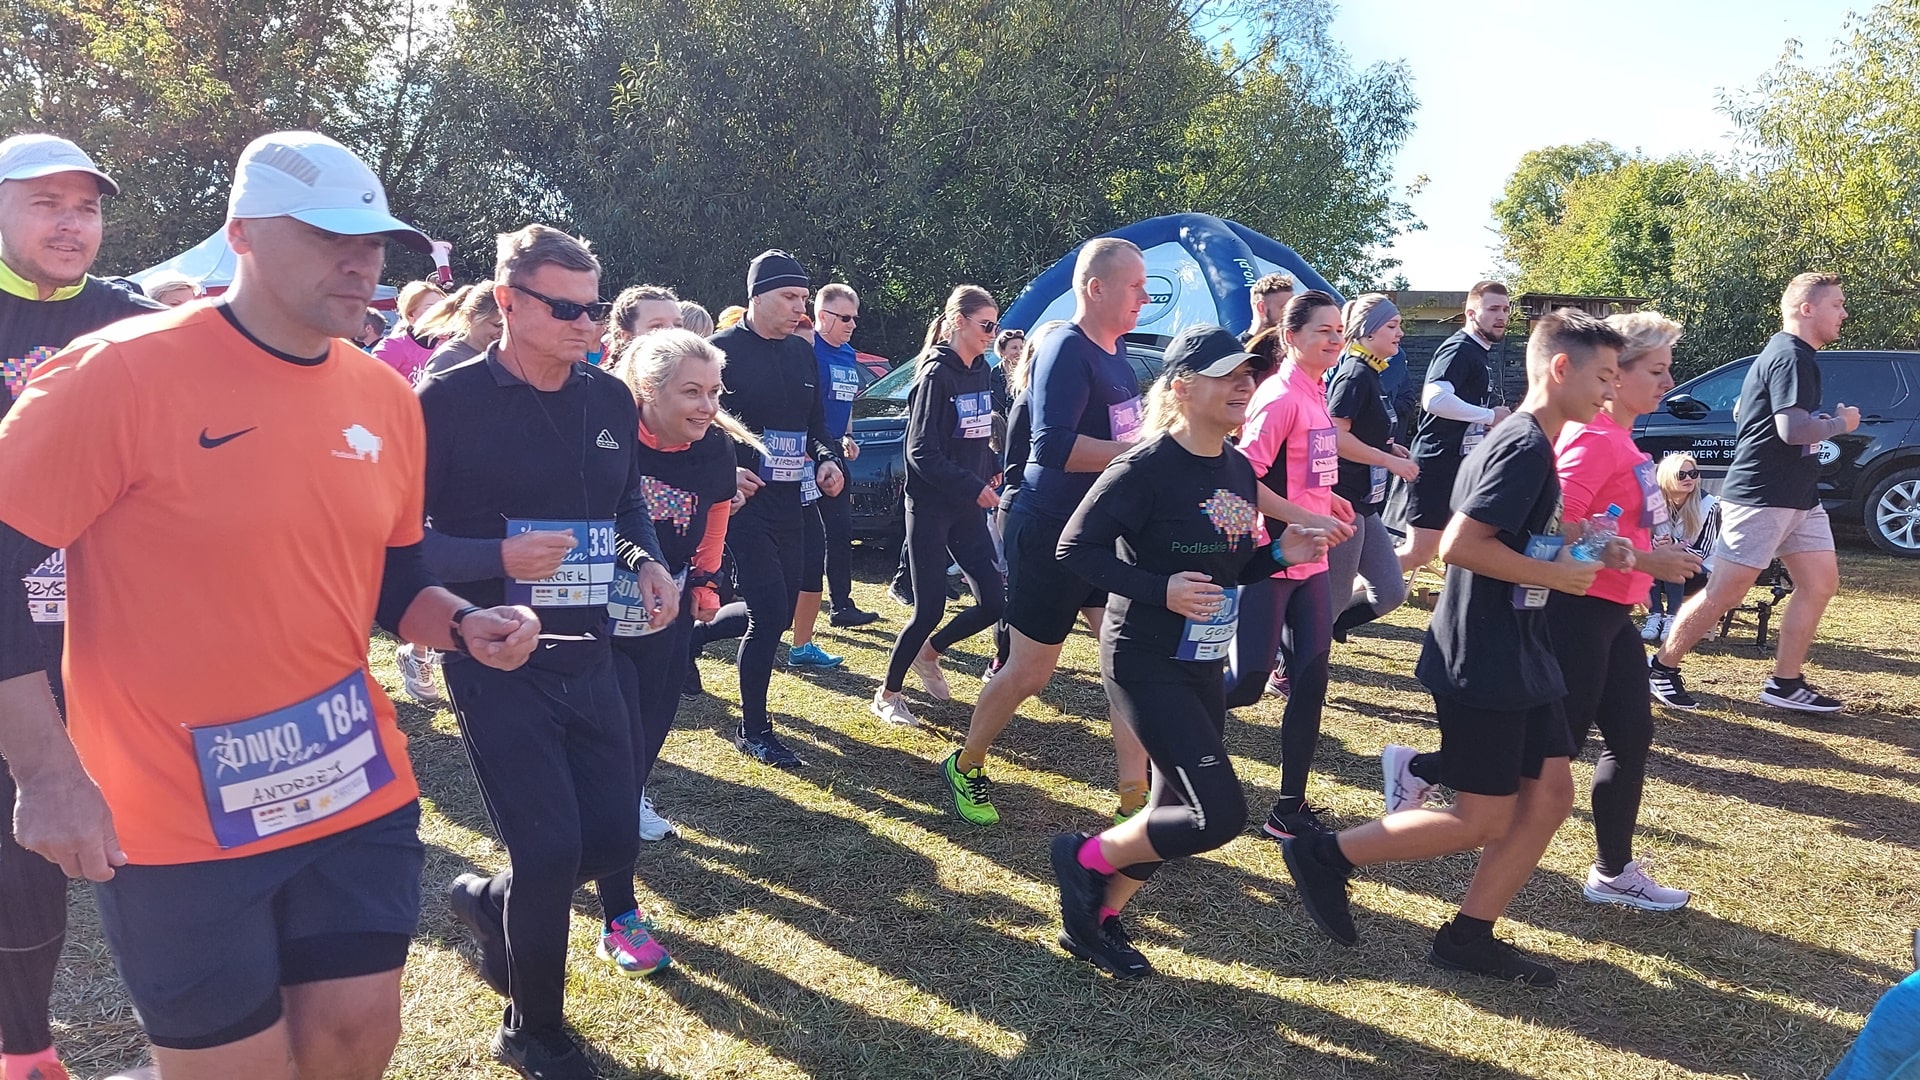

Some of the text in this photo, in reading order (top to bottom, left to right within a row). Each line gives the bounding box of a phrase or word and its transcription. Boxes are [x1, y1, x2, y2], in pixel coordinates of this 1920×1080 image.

[1692, 439, 1718, 447] JAZDA
[1171, 541, 1228, 554] Podlaskie
[316, 683, 368, 742] 184
